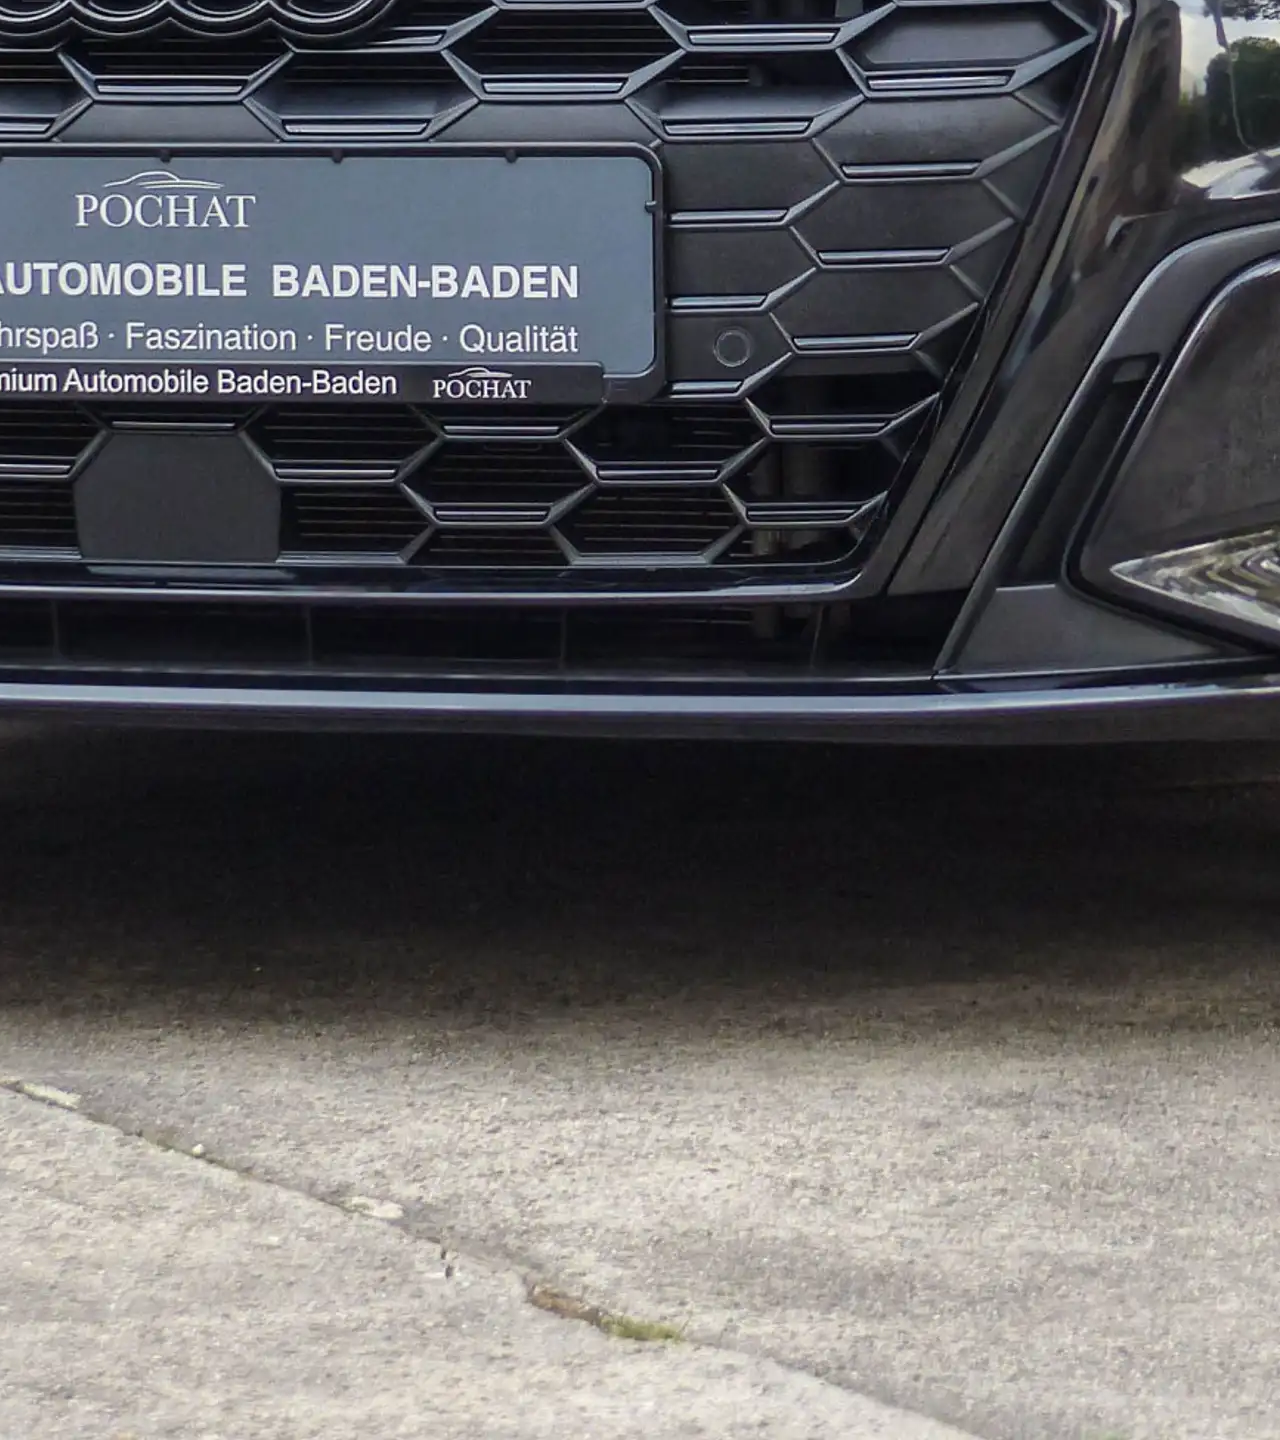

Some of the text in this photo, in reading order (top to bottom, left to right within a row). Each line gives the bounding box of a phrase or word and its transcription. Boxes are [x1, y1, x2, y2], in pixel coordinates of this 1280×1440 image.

[75, 194, 257, 229] POCHAT
[272, 264, 579, 299] BADEN-BADEN
[125, 321, 298, 353] Faszination
[324, 323, 433, 353] Freude
[458, 323, 580, 355] Qualität
[62, 367, 210, 394] Automobile
[216, 368, 399, 396] Baden-Baden
[432, 378, 532, 399] POCHAT
